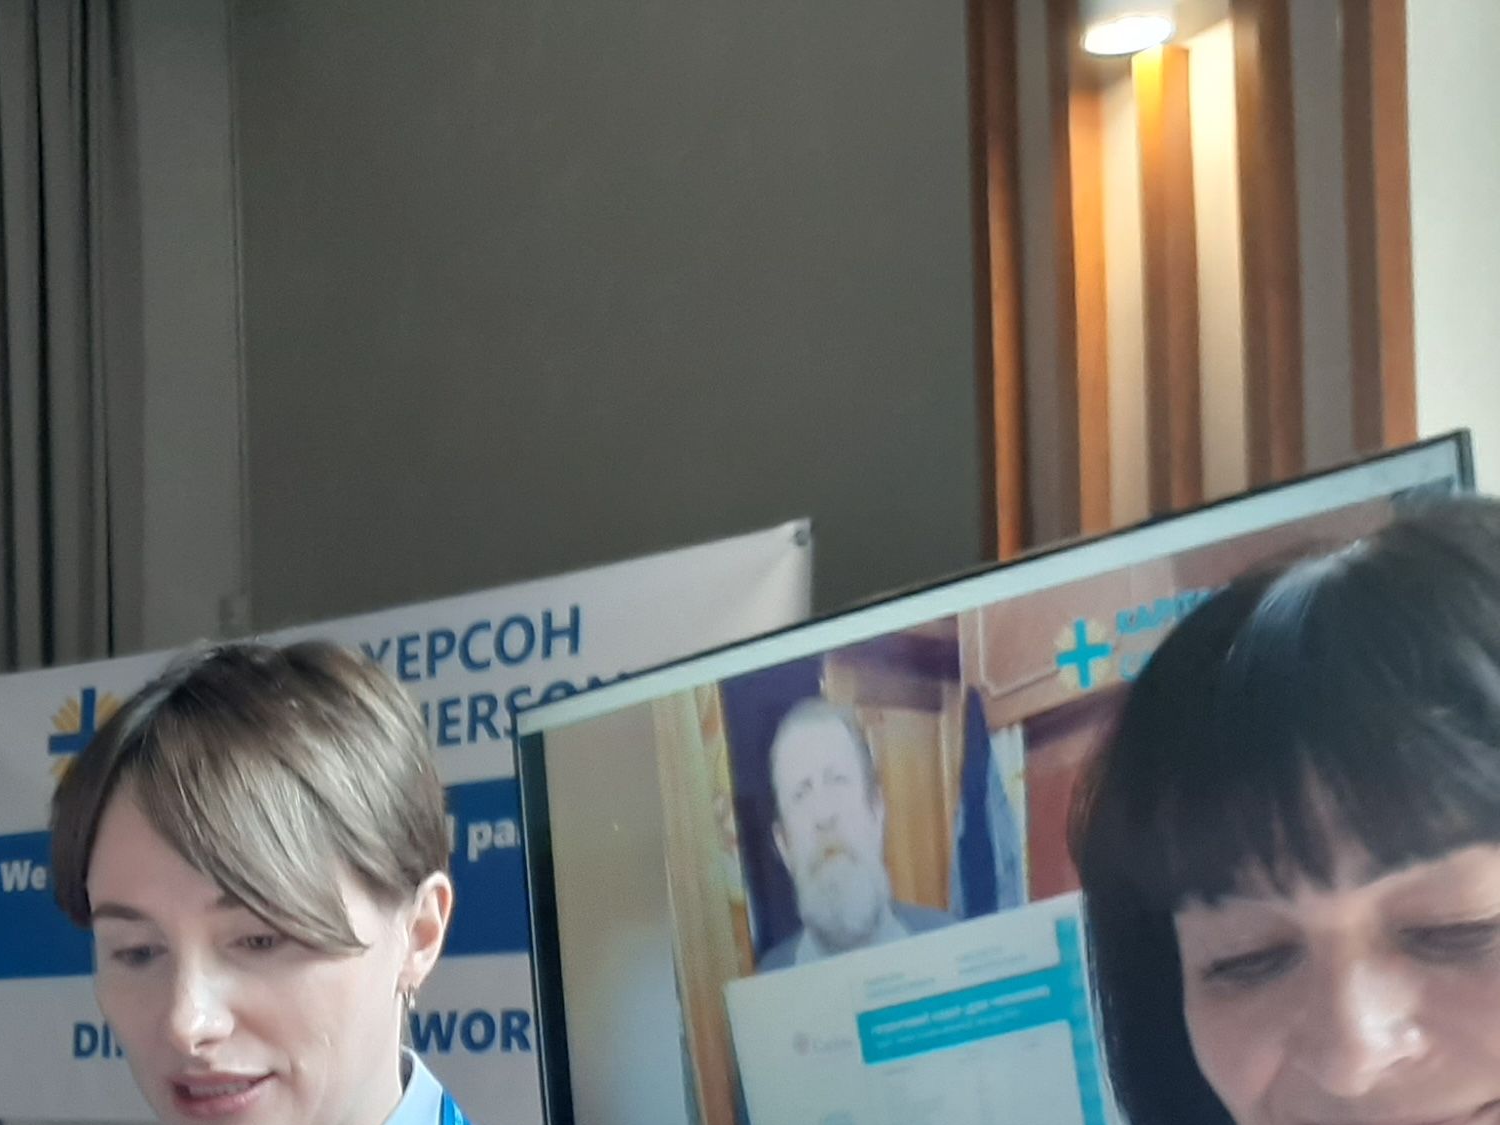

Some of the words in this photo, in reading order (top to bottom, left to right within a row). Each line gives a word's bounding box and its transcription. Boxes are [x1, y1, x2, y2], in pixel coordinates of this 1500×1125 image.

[467, 818, 521, 862] pa
[0, 859, 48, 892] We
[73, 1021, 124, 1059] DI
